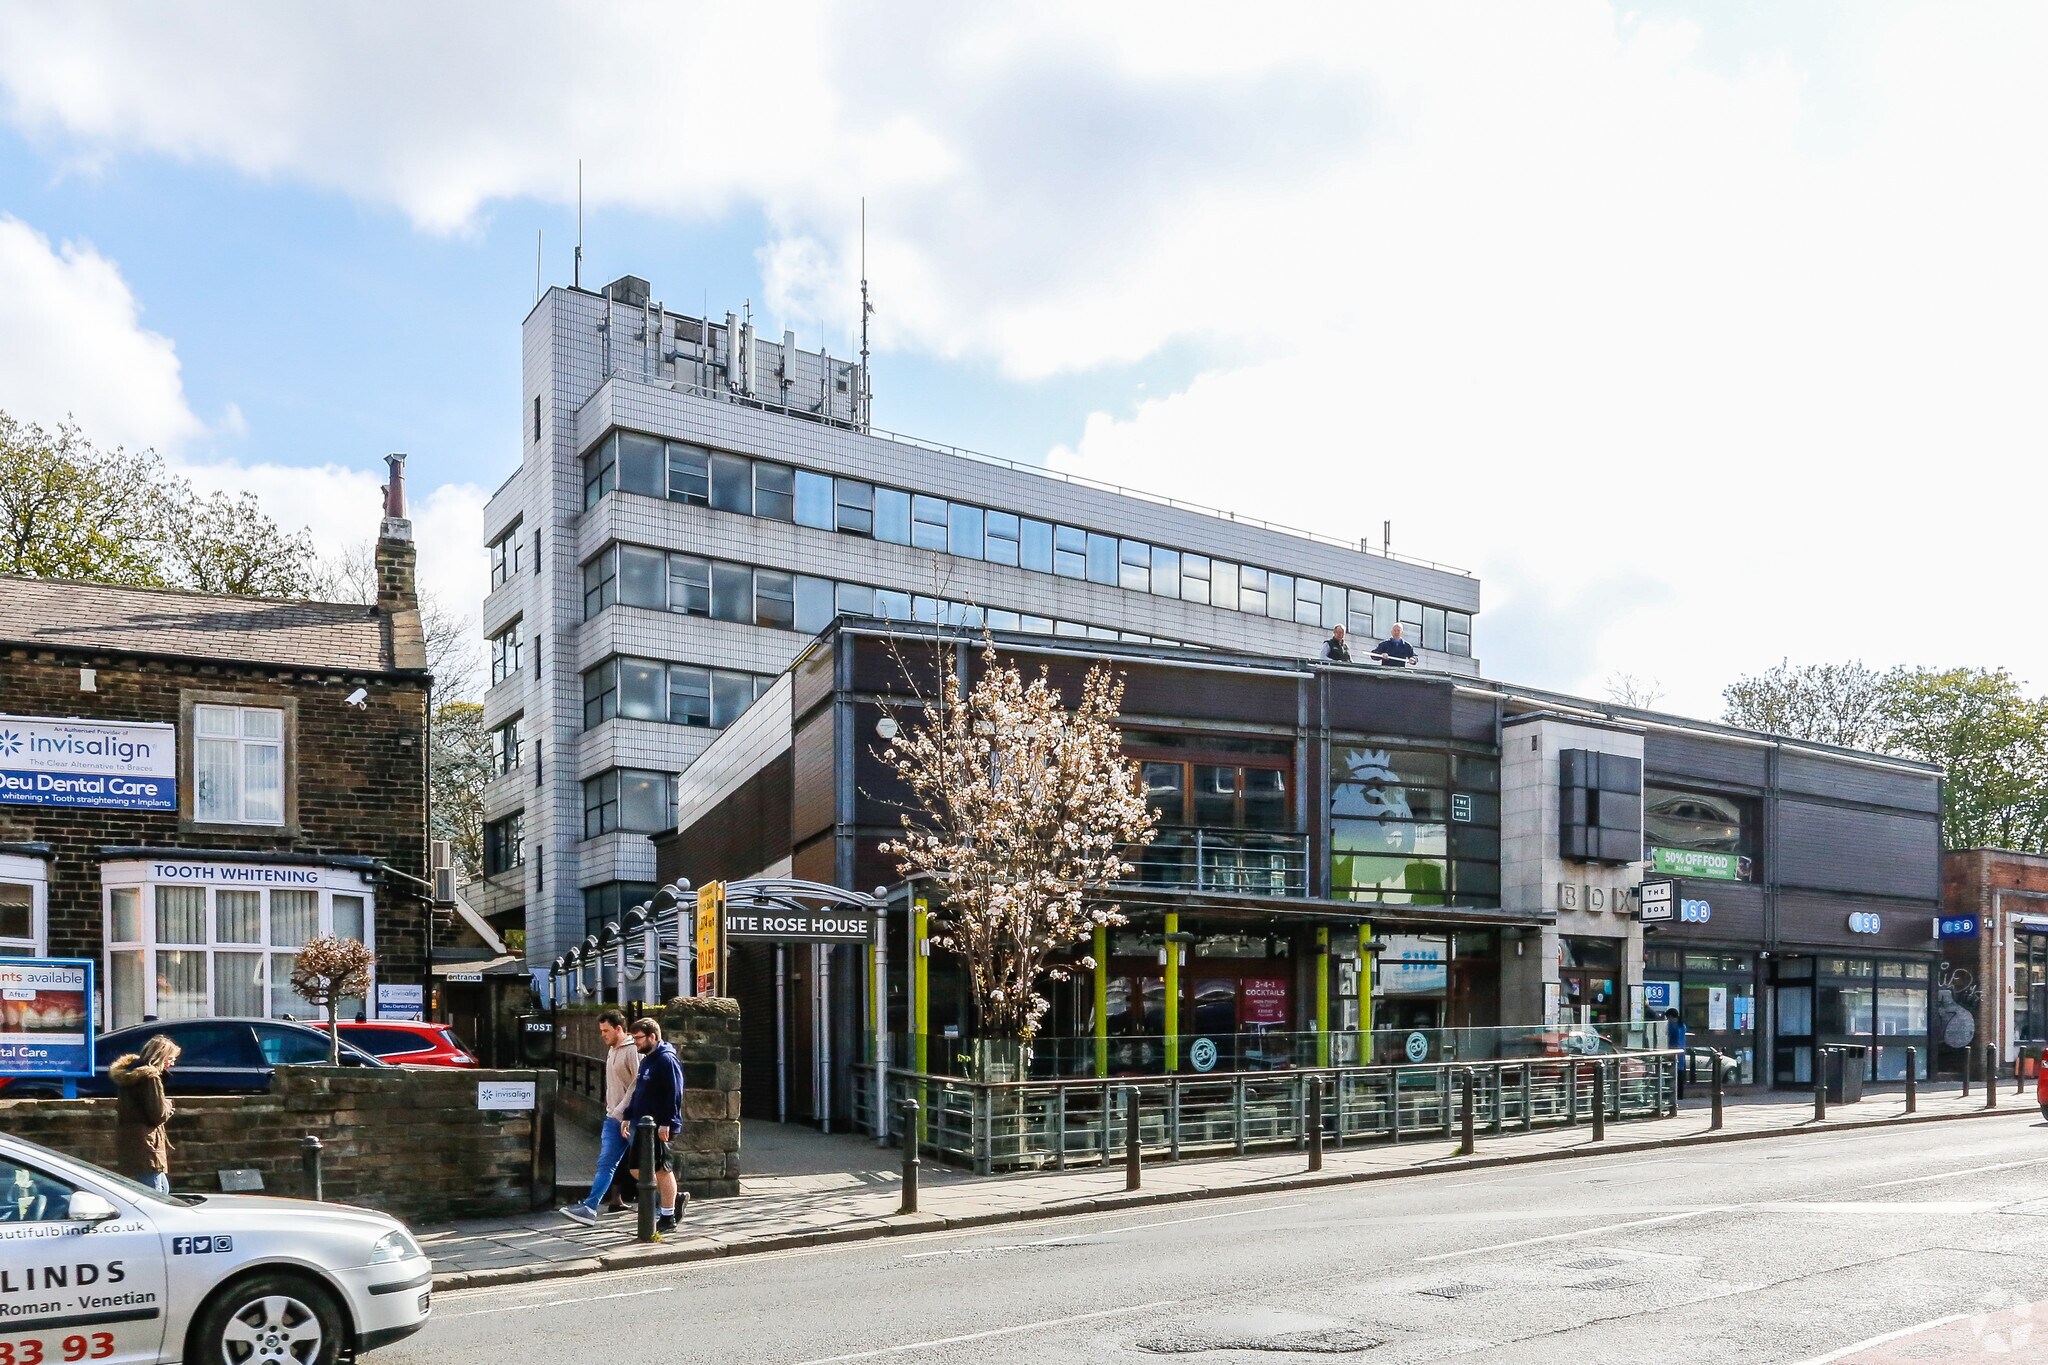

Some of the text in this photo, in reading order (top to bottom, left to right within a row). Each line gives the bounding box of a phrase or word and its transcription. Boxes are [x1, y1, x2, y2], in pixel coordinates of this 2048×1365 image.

[30, 732, 150, 762] invisalign
[46, 760, 68, 768] Clear
[70, 761, 114, 770] Alternative
[37, 775, 105, 794] Dental
[108, 778, 158, 796] Care
[2, 791, 171, 807] whitening Tooth straightening Implants
[1665, 851, 1728, 868] 50% OFF FOOD
[154, 865, 318, 884] TOOTH WHITENING
[763, 917, 807, 932] ROSE
[812, 918, 868, 933] HOUSE
[27, 972, 83, 984] available
[448, 972, 481, 981] entrance
[1255, 980, 1276, 988] 2-4-1
[1245, 989, 1285, 997] COCKTAILS
[527, 1023, 552, 1031] POST
[19, 1047, 48, 1057] Care
[495, 1090, 531, 1100] invisalign
[1, 1260, 125, 1293] LINDS
[0, 1301, 61, 1316] Roman
[78, 1291, 156, 1309] Venetian
[62, 1332, 115, 1362] 93
